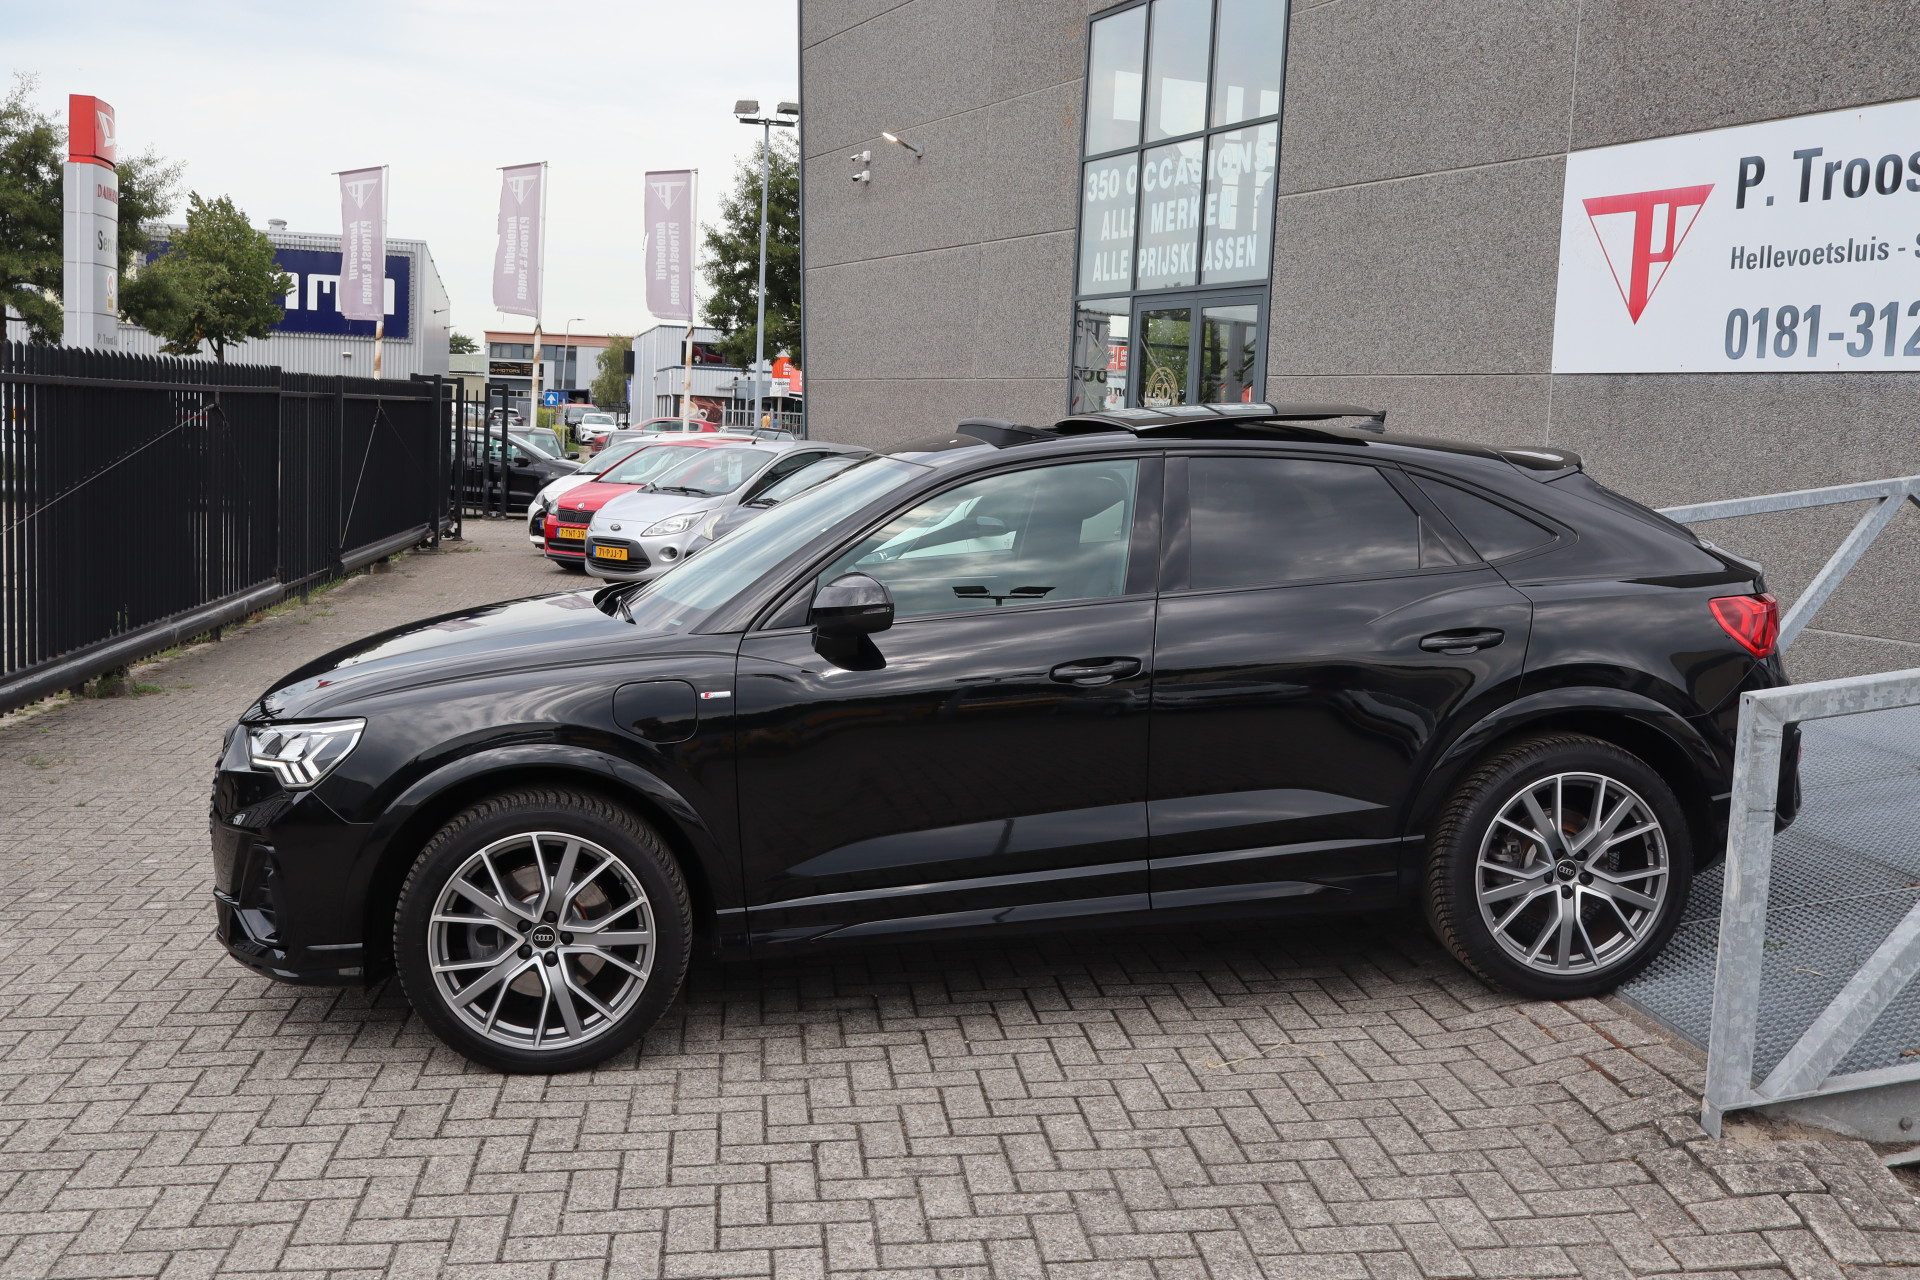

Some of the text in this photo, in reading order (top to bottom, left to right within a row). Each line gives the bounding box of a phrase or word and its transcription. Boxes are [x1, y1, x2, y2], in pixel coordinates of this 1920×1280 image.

[1087, 139, 1269, 202] 350 OCCASIONS
[1735, 155, 1775, 210] P.
[1100, 189, 1232, 241] ALLE MERKEN
[1092, 234, 1257, 282] ALLE PRIJSKLASSEN
[1730, 236, 1890, 270] Hellevoetsluis
[1724, 300, 1920, 360] 0181-312
[561, 528, 585, 537] 7-TNT-39
[598, 547, 623, 559] 71-PJJ-7
